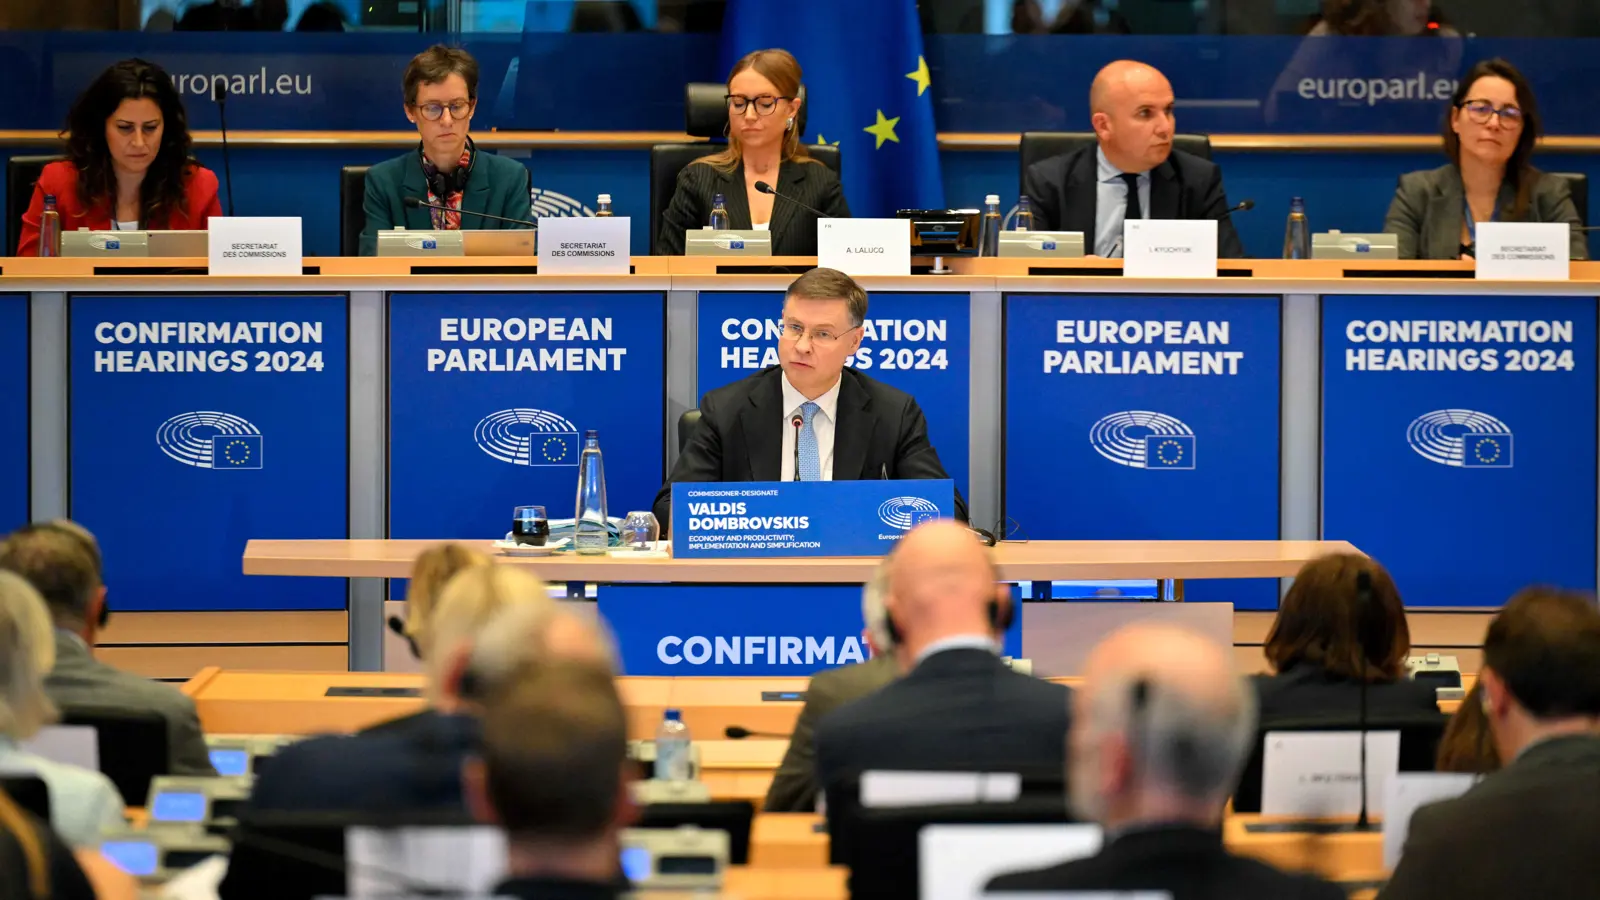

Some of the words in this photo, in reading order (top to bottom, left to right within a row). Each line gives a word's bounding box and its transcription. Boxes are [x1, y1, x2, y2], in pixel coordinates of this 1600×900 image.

[172, 66, 312, 101] roparl.eu
[94, 321, 322, 344] CONFIRMATION
[440, 317, 612, 341] EUROPEAN
[720, 318, 947, 341] CONATION
[1056, 320, 1230, 344] EUROPEAN
[1345, 320, 1573, 343] CONFIRMATION
[94, 350, 249, 372] HEARINGS
[254, 351, 324, 372] 2024
[427, 348, 627, 372] PARLIAMENT
[879, 349, 949, 370] 2024
[1043, 350, 1244, 375] PARLIAMENT
[1345, 349, 1499, 371] HEARINGS
[1504, 349, 1574, 371] 2024
[688, 502, 747, 515] VALDIS
[688, 516, 810, 530] DOMBROVSKIS
[688, 542, 749, 550] IMPLEMENTATION
[767, 541, 821, 549] SIMPLIFICATION
[656, 635, 872, 665] CONFIRMA
